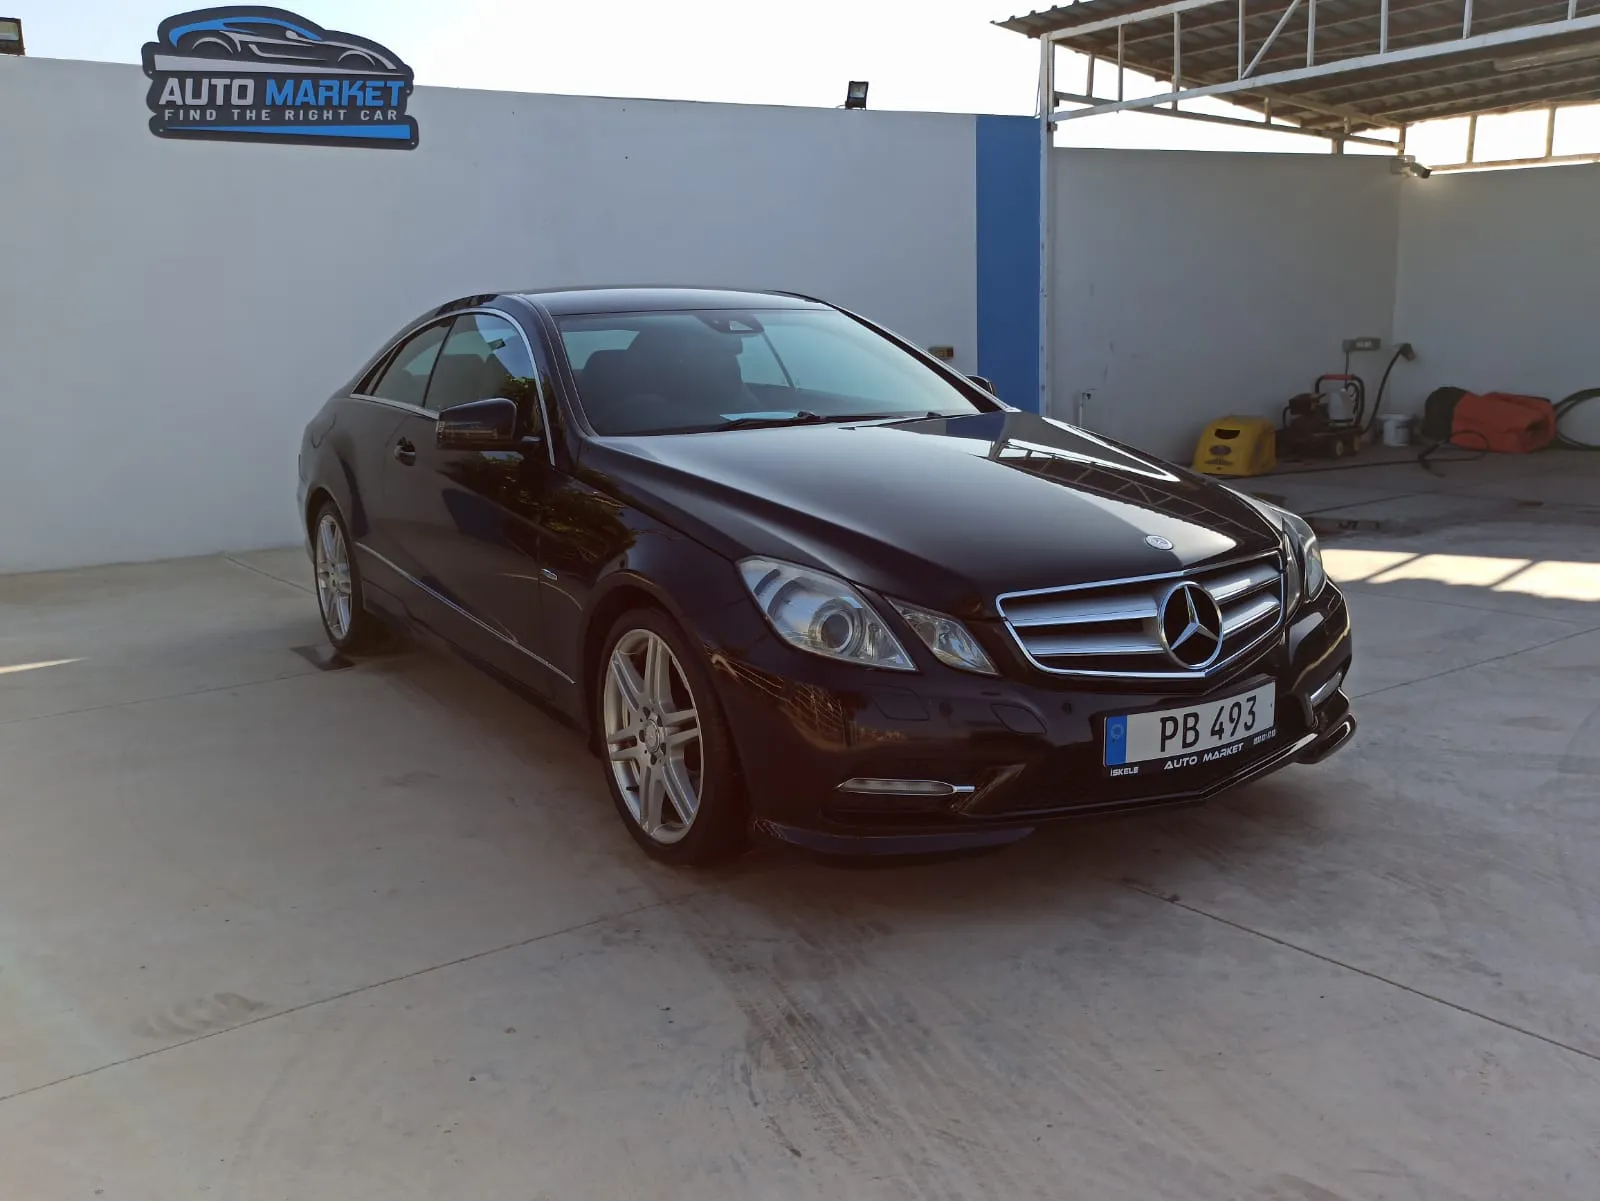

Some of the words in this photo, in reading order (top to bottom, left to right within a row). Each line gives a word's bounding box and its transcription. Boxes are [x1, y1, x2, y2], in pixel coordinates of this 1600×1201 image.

[159, 78, 254, 106] AUTO
[265, 79, 405, 107] MARKET
[165, 109, 217, 121] FIND
[232, 109, 271, 121] THE
[285, 109, 347, 121] RIGHT
[360, 109, 397, 121] CAR
[1160, 712, 1199, 753] PB
[1210, 695, 1257, 741] 493
[1164, 756, 1198, 770] AUTO
[1203, 743, 1244, 762] MARKET
